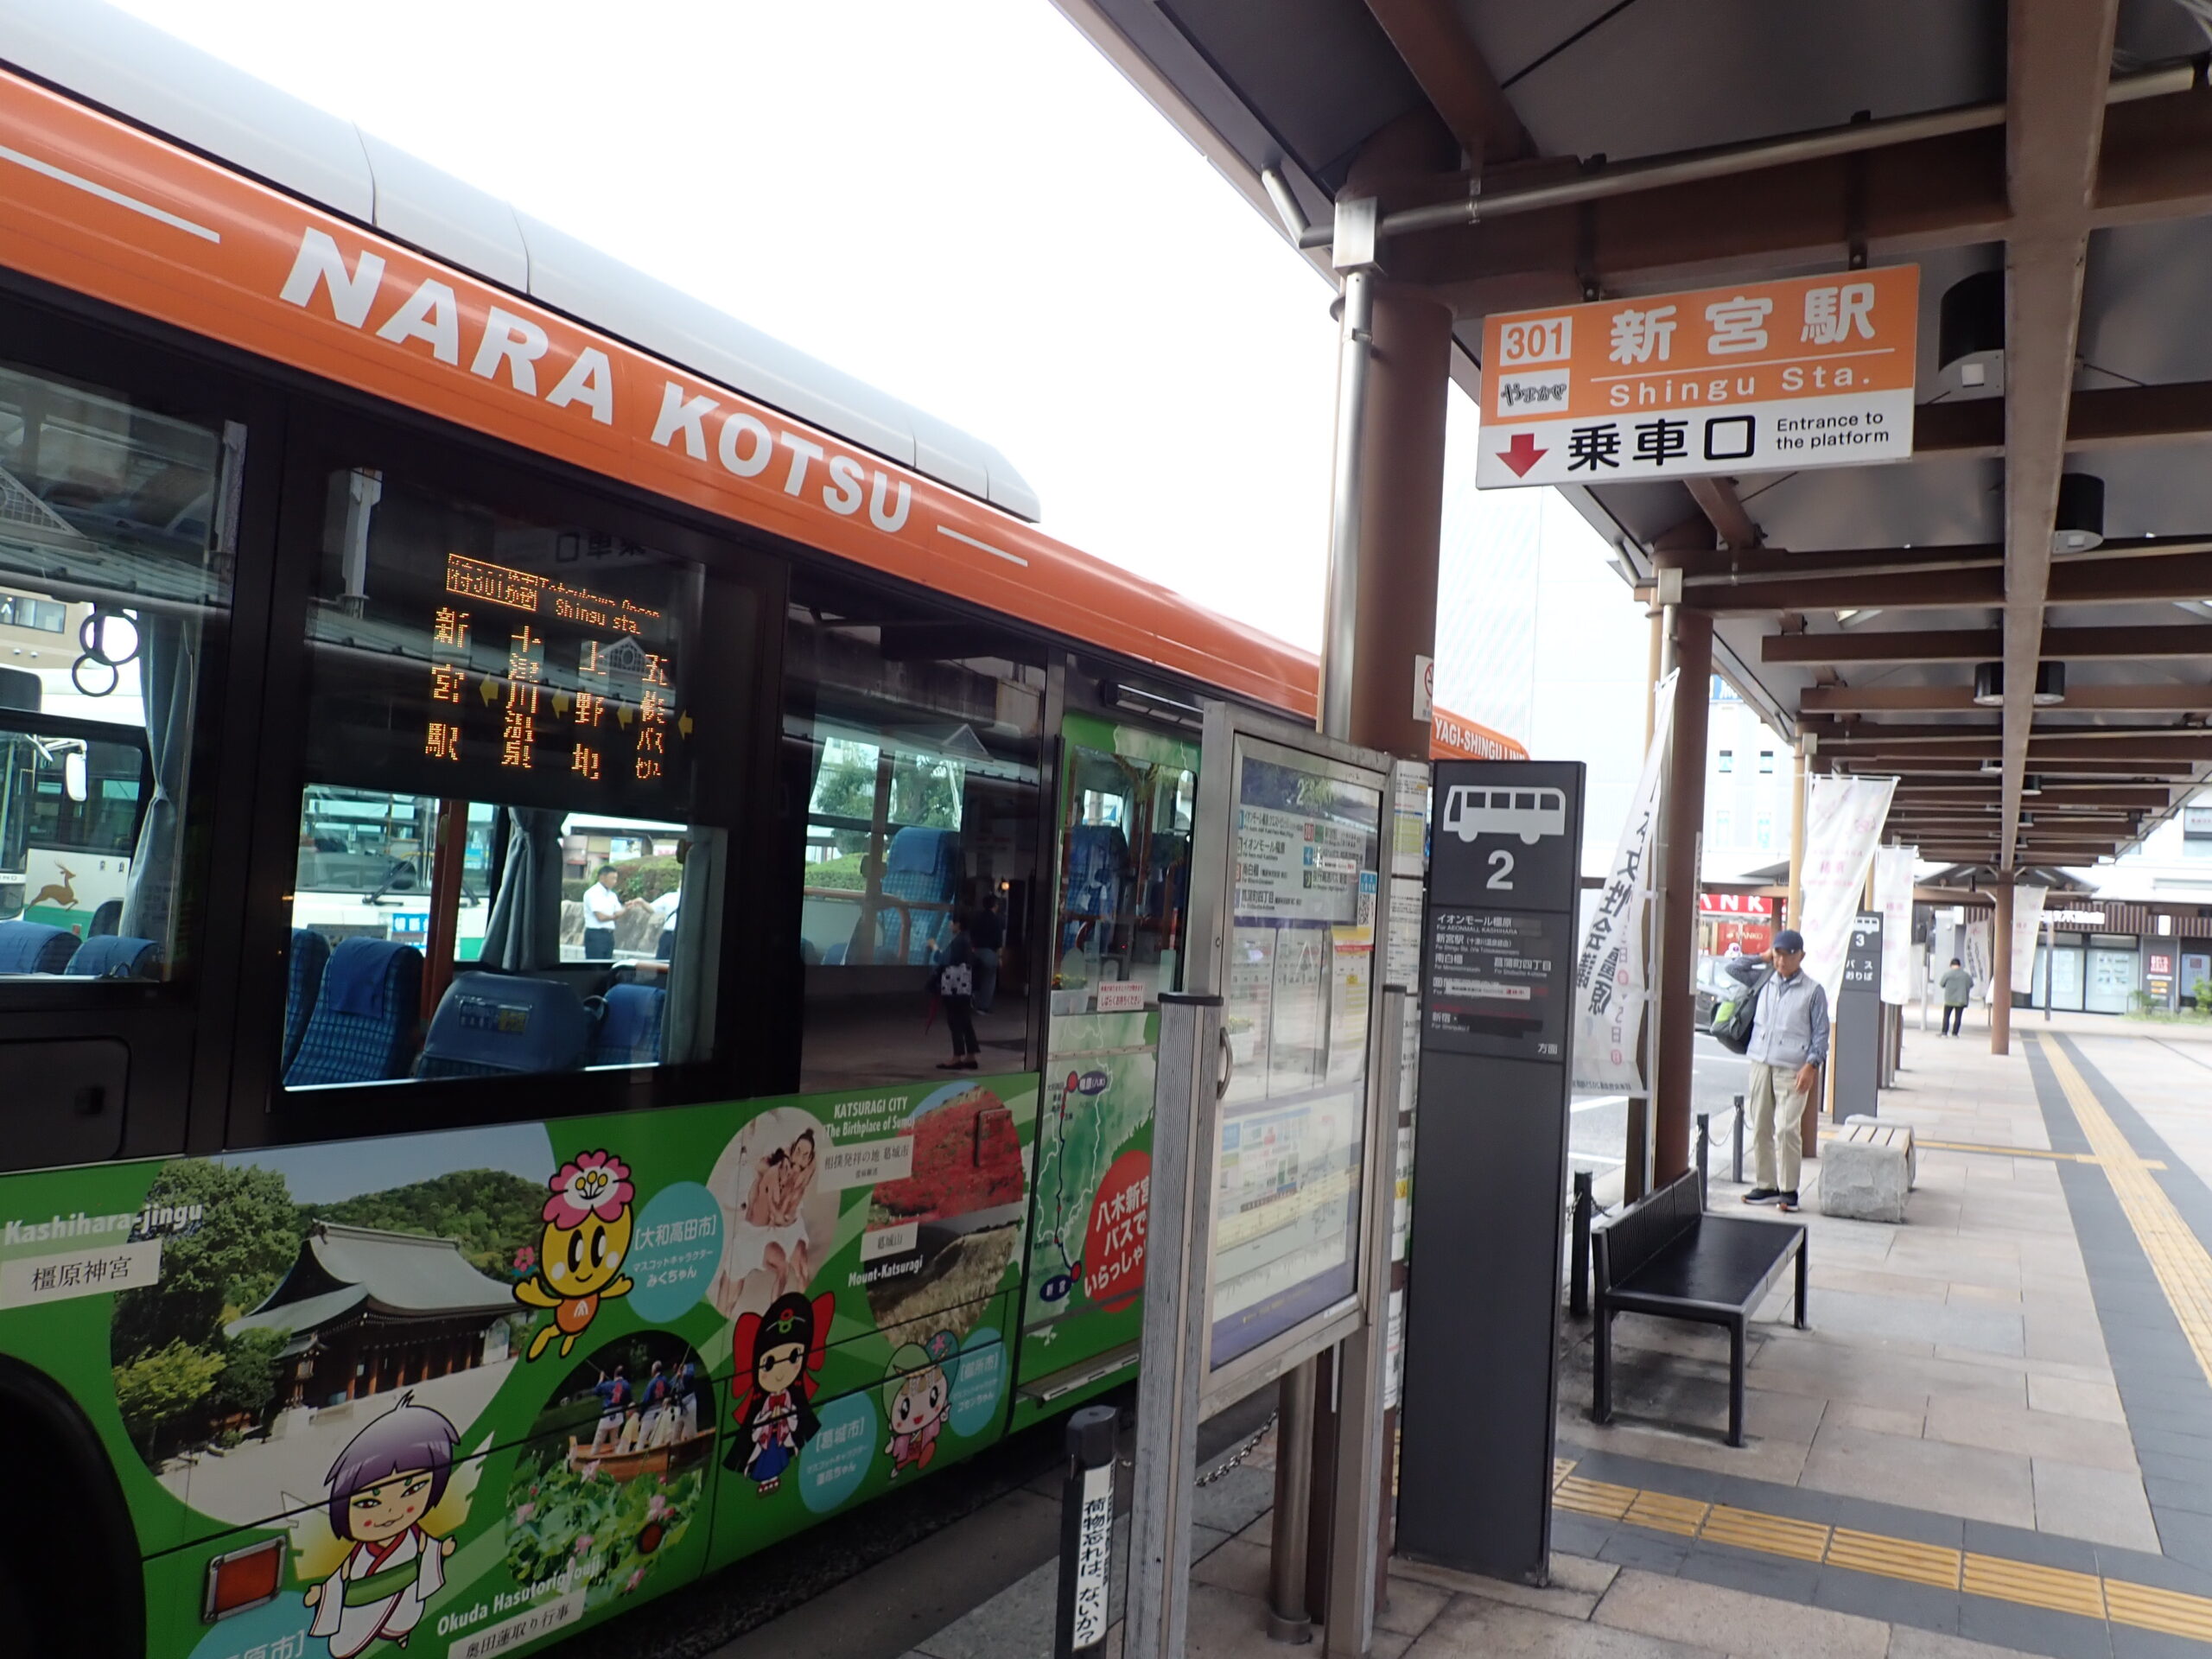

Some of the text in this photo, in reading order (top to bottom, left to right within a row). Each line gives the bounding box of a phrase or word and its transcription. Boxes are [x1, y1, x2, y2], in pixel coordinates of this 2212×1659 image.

[1506, 322, 1565, 359] 301
[1610, 283, 1875, 365] 新宮駅
[278, 226, 912, 533] NARA KOTSU
[1610, 365, 1870, 408] Shingu Sta.
[1777, 412, 1884, 433] Entrance to
[1567, 416, 1757, 472] 乗車口
[1776, 430, 1890, 450] the platform
[556, 598, 606, 626] Shingu
[1486, 850, 1515, 890] 2
[1438, 913, 1512, 927] イオンモール橿原
[1436, 933, 1465, 945] 新宮駅
[1855, 934, 1866, 947] 3
[834, 1096, 908, 1119] KATSURAGI CITY
[842, 1119, 881, 1138] Birthplace
[882, 1116, 892, 1130] of
[4, 1204, 203, 1246] Kashihara-jingu
[1104, 1210, 1147, 1257] バスで
[31, 1256, 132, 1292] 橿原神宮
[632, 1249, 713, 1273] マスコットキャラクター
[646, 1265, 697, 1287] みくちゃん
[848, 1254, 924, 1287] Mount-Katsuragi
[1084, 1240, 1147, 1298] いらっしゃ
[437, 1602, 489, 1637] Okuda
[226, 1629, 305, 1659] 原市]
